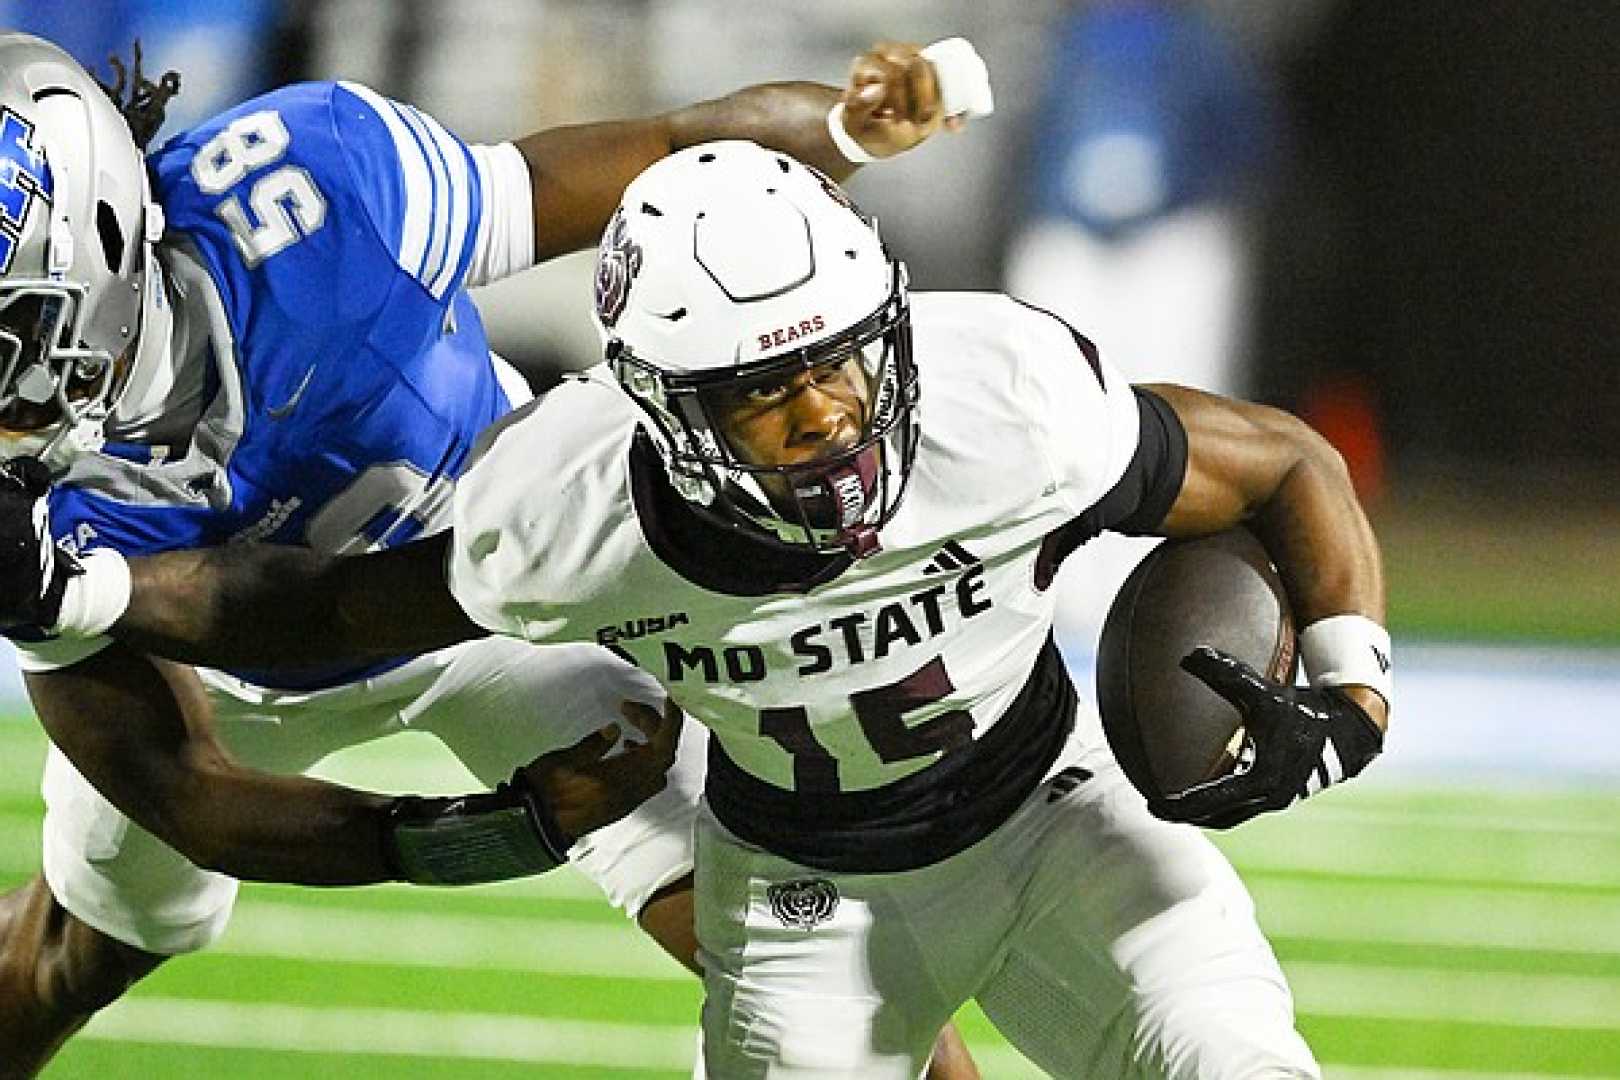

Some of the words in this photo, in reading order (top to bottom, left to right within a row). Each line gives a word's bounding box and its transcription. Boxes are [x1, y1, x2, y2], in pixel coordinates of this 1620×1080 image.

[191, 109, 327, 271] 85
[758, 315, 824, 351] BEARS
[663, 642, 767, 684] MO
[790, 562, 993, 676] STATE
[758, 654, 977, 792] 15
